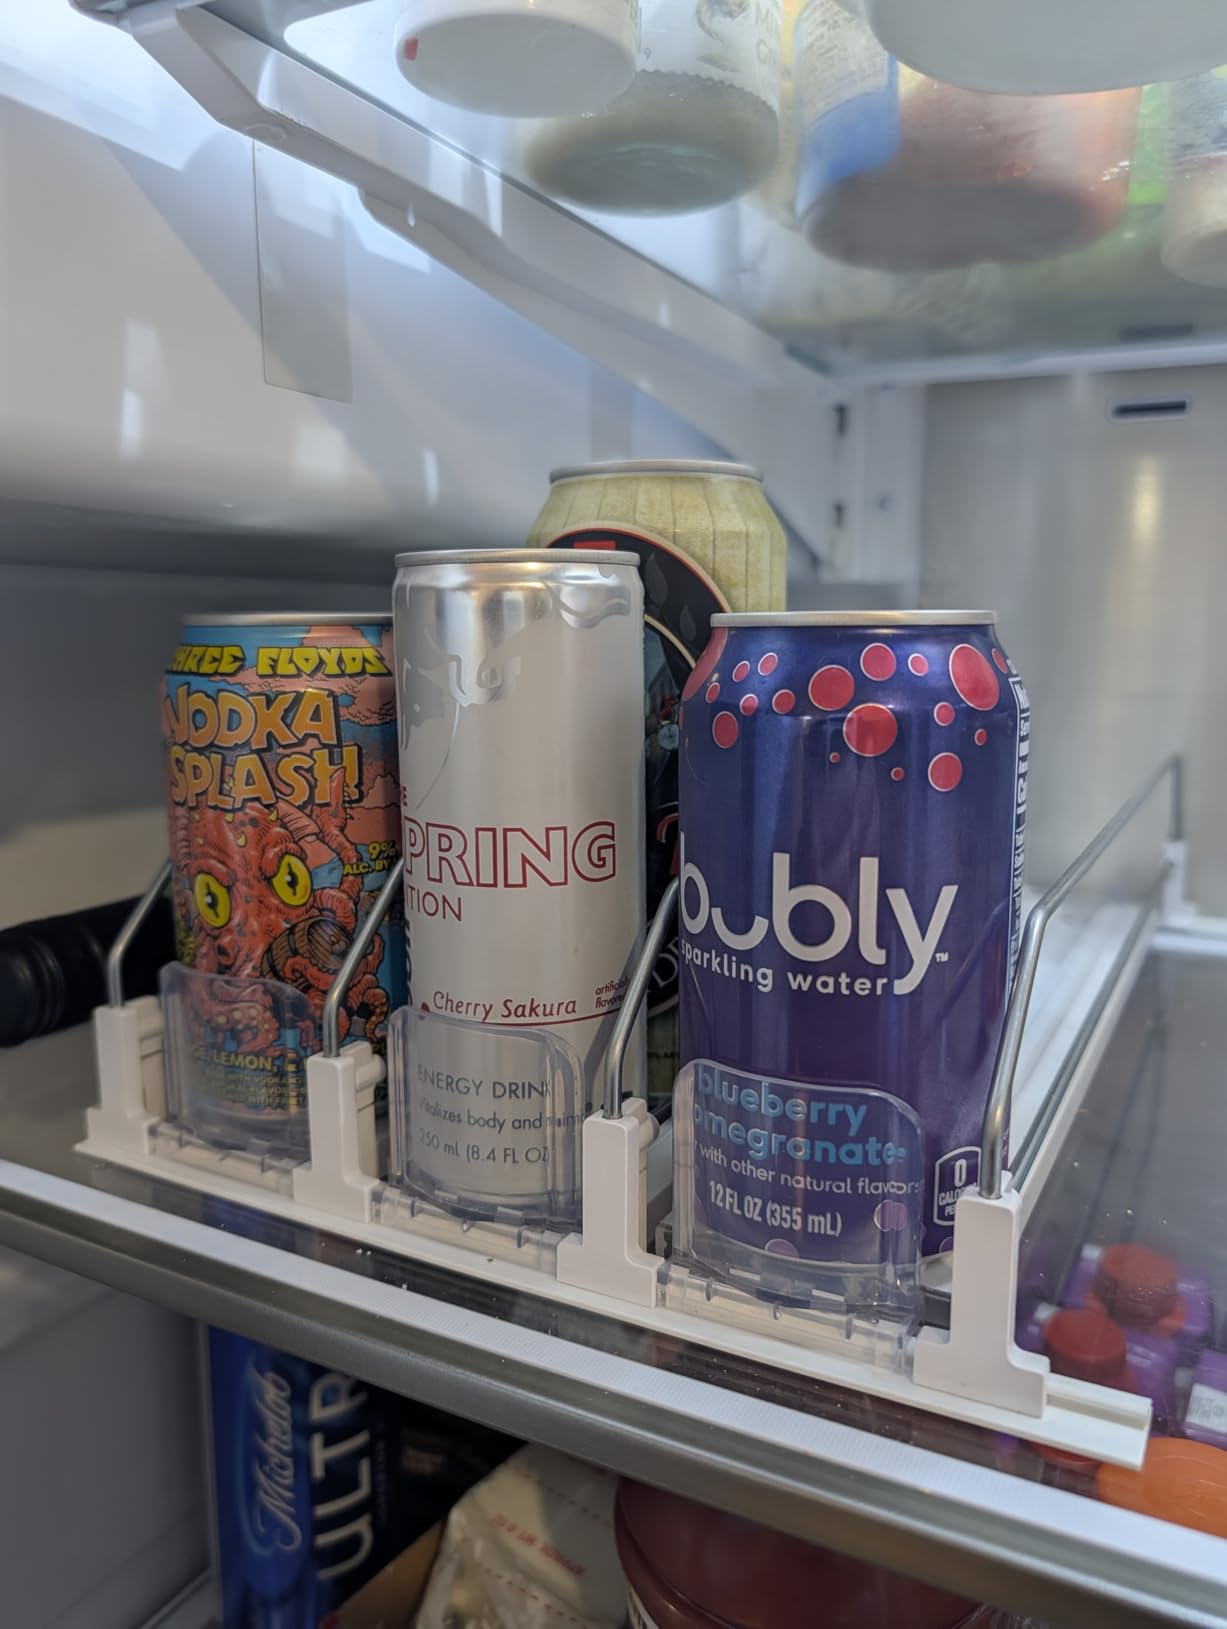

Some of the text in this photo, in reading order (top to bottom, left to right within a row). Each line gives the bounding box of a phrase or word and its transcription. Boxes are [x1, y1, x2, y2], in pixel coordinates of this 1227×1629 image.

[166, 644, 391, 676] HREE FLOYDS
[167, 682, 340, 750] VODKA
[169, 743, 363, 809] SPLASH!
[403, 815, 616, 889] PRING
[679, 830, 959, 995] bubly
[681, 936, 774, 993] sparkling
[787, 975, 889, 996] water
[433, 991, 577, 1021] Cherry Sakura
[418, 1064, 483, 1097] ENERGY
[697, 1064, 867, 1136] blueberry
[467, 1109, 507, 1133] body
[512, 1112, 542, 1129] and
[694, 1103, 906, 1166] omegranate
[466, 1143, 496, 1165] (8.4
[503, 1147, 519, 1164] FL
[700, 1142, 728, 1169] with
[731, 1159, 777, 1184] other
[780, 1171, 853, 1195] natural
[954, 1158, 968, 1187] 0
[744, 1194, 763, 1222] OZ
[766, 1199, 803, 1231] (355
[807, 1209, 843, 1238] mL)
[938, 1188, 962, 1206] CALO
[309, 1370, 373, 1582] ULTR
